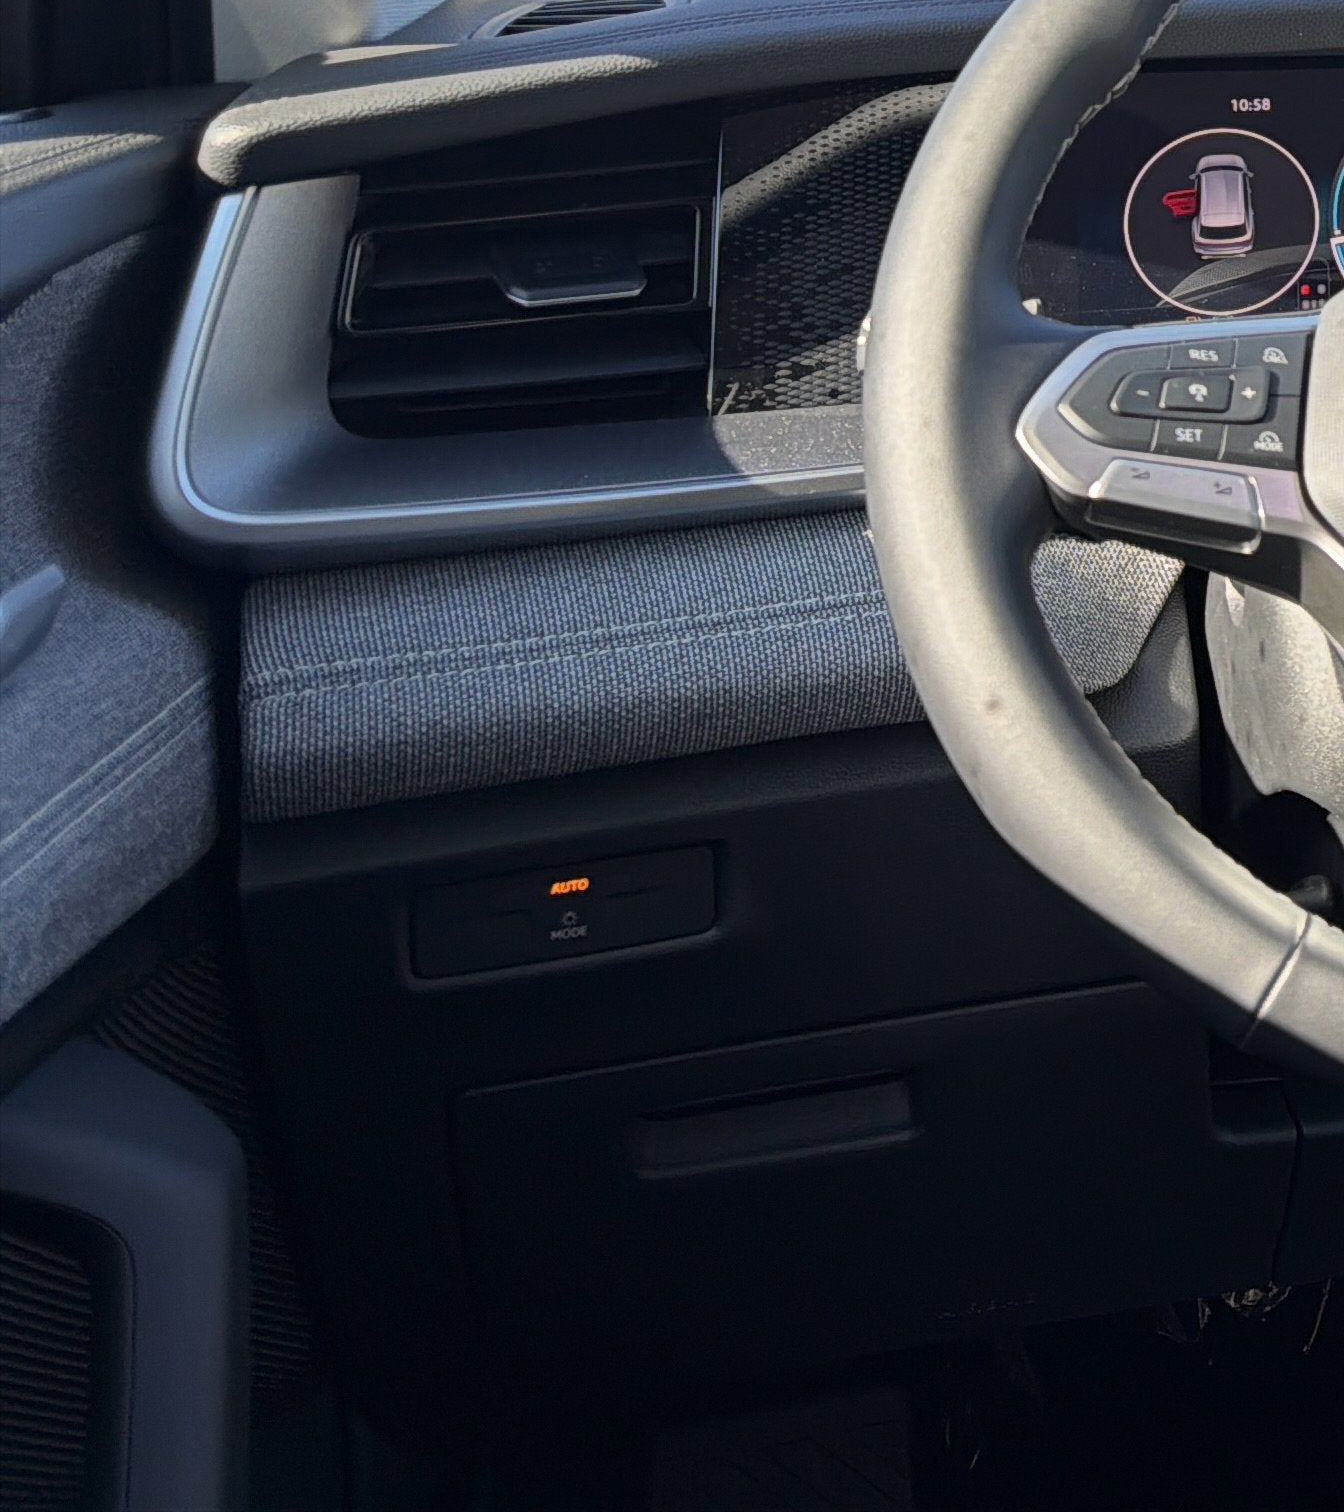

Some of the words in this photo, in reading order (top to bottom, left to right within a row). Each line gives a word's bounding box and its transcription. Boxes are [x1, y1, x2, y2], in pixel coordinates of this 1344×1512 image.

[1230, 97, 1271, 112] 10:58
[1188, 348, 1219, 363] RES
[1174, 427, 1203, 443] SET
[550, 878, 590, 896] AUTO
[550, 925, 589, 942] MODE
